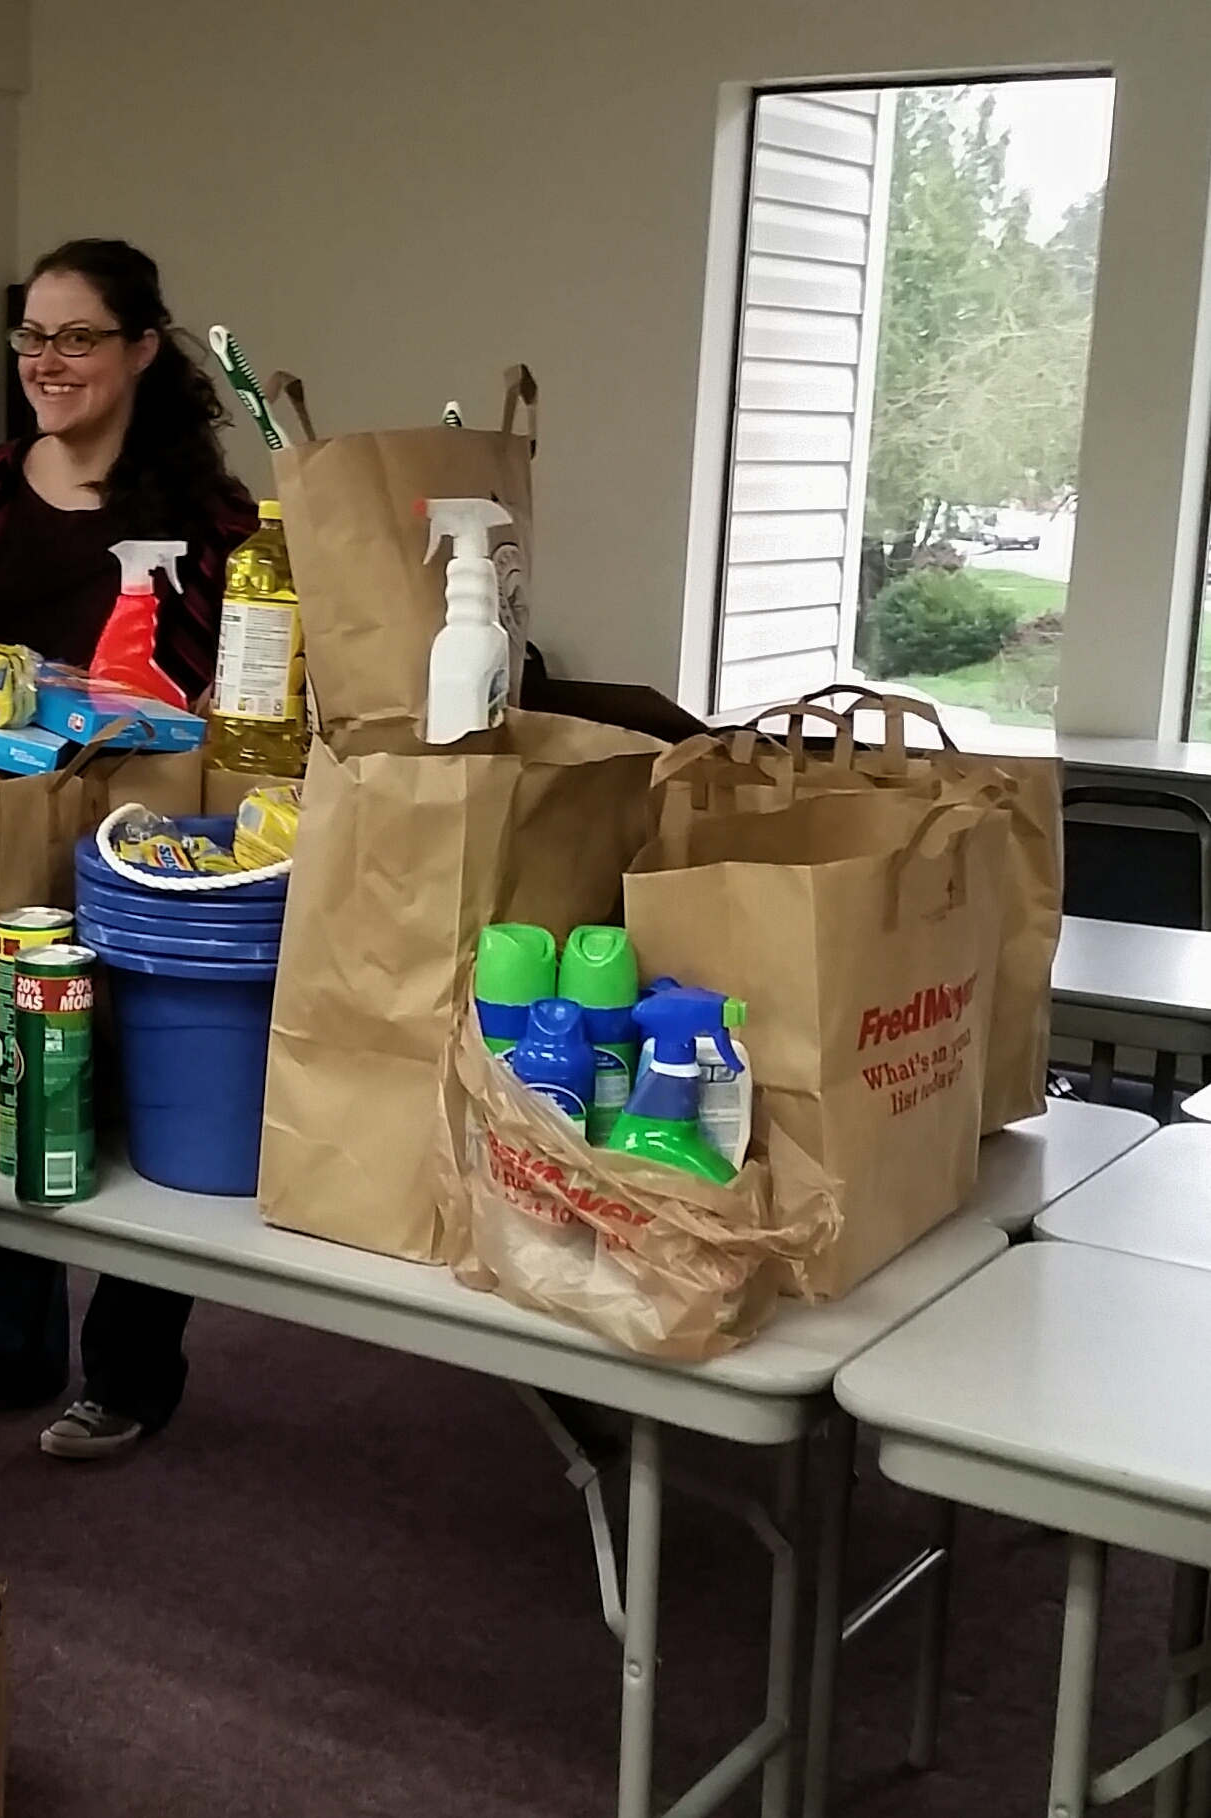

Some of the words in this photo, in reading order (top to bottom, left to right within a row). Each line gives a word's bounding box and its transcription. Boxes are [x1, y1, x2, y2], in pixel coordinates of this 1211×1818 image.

[17, 977, 42, 995] 20%
[66, 978, 92, 996] 20%
[16, 991, 44, 1011] MAS
[59, 992, 94, 1012] MOR
[857, 991, 922, 1052] Fred
[862, 1052, 930, 1091] What's
[891, 1086, 918, 1116] list
